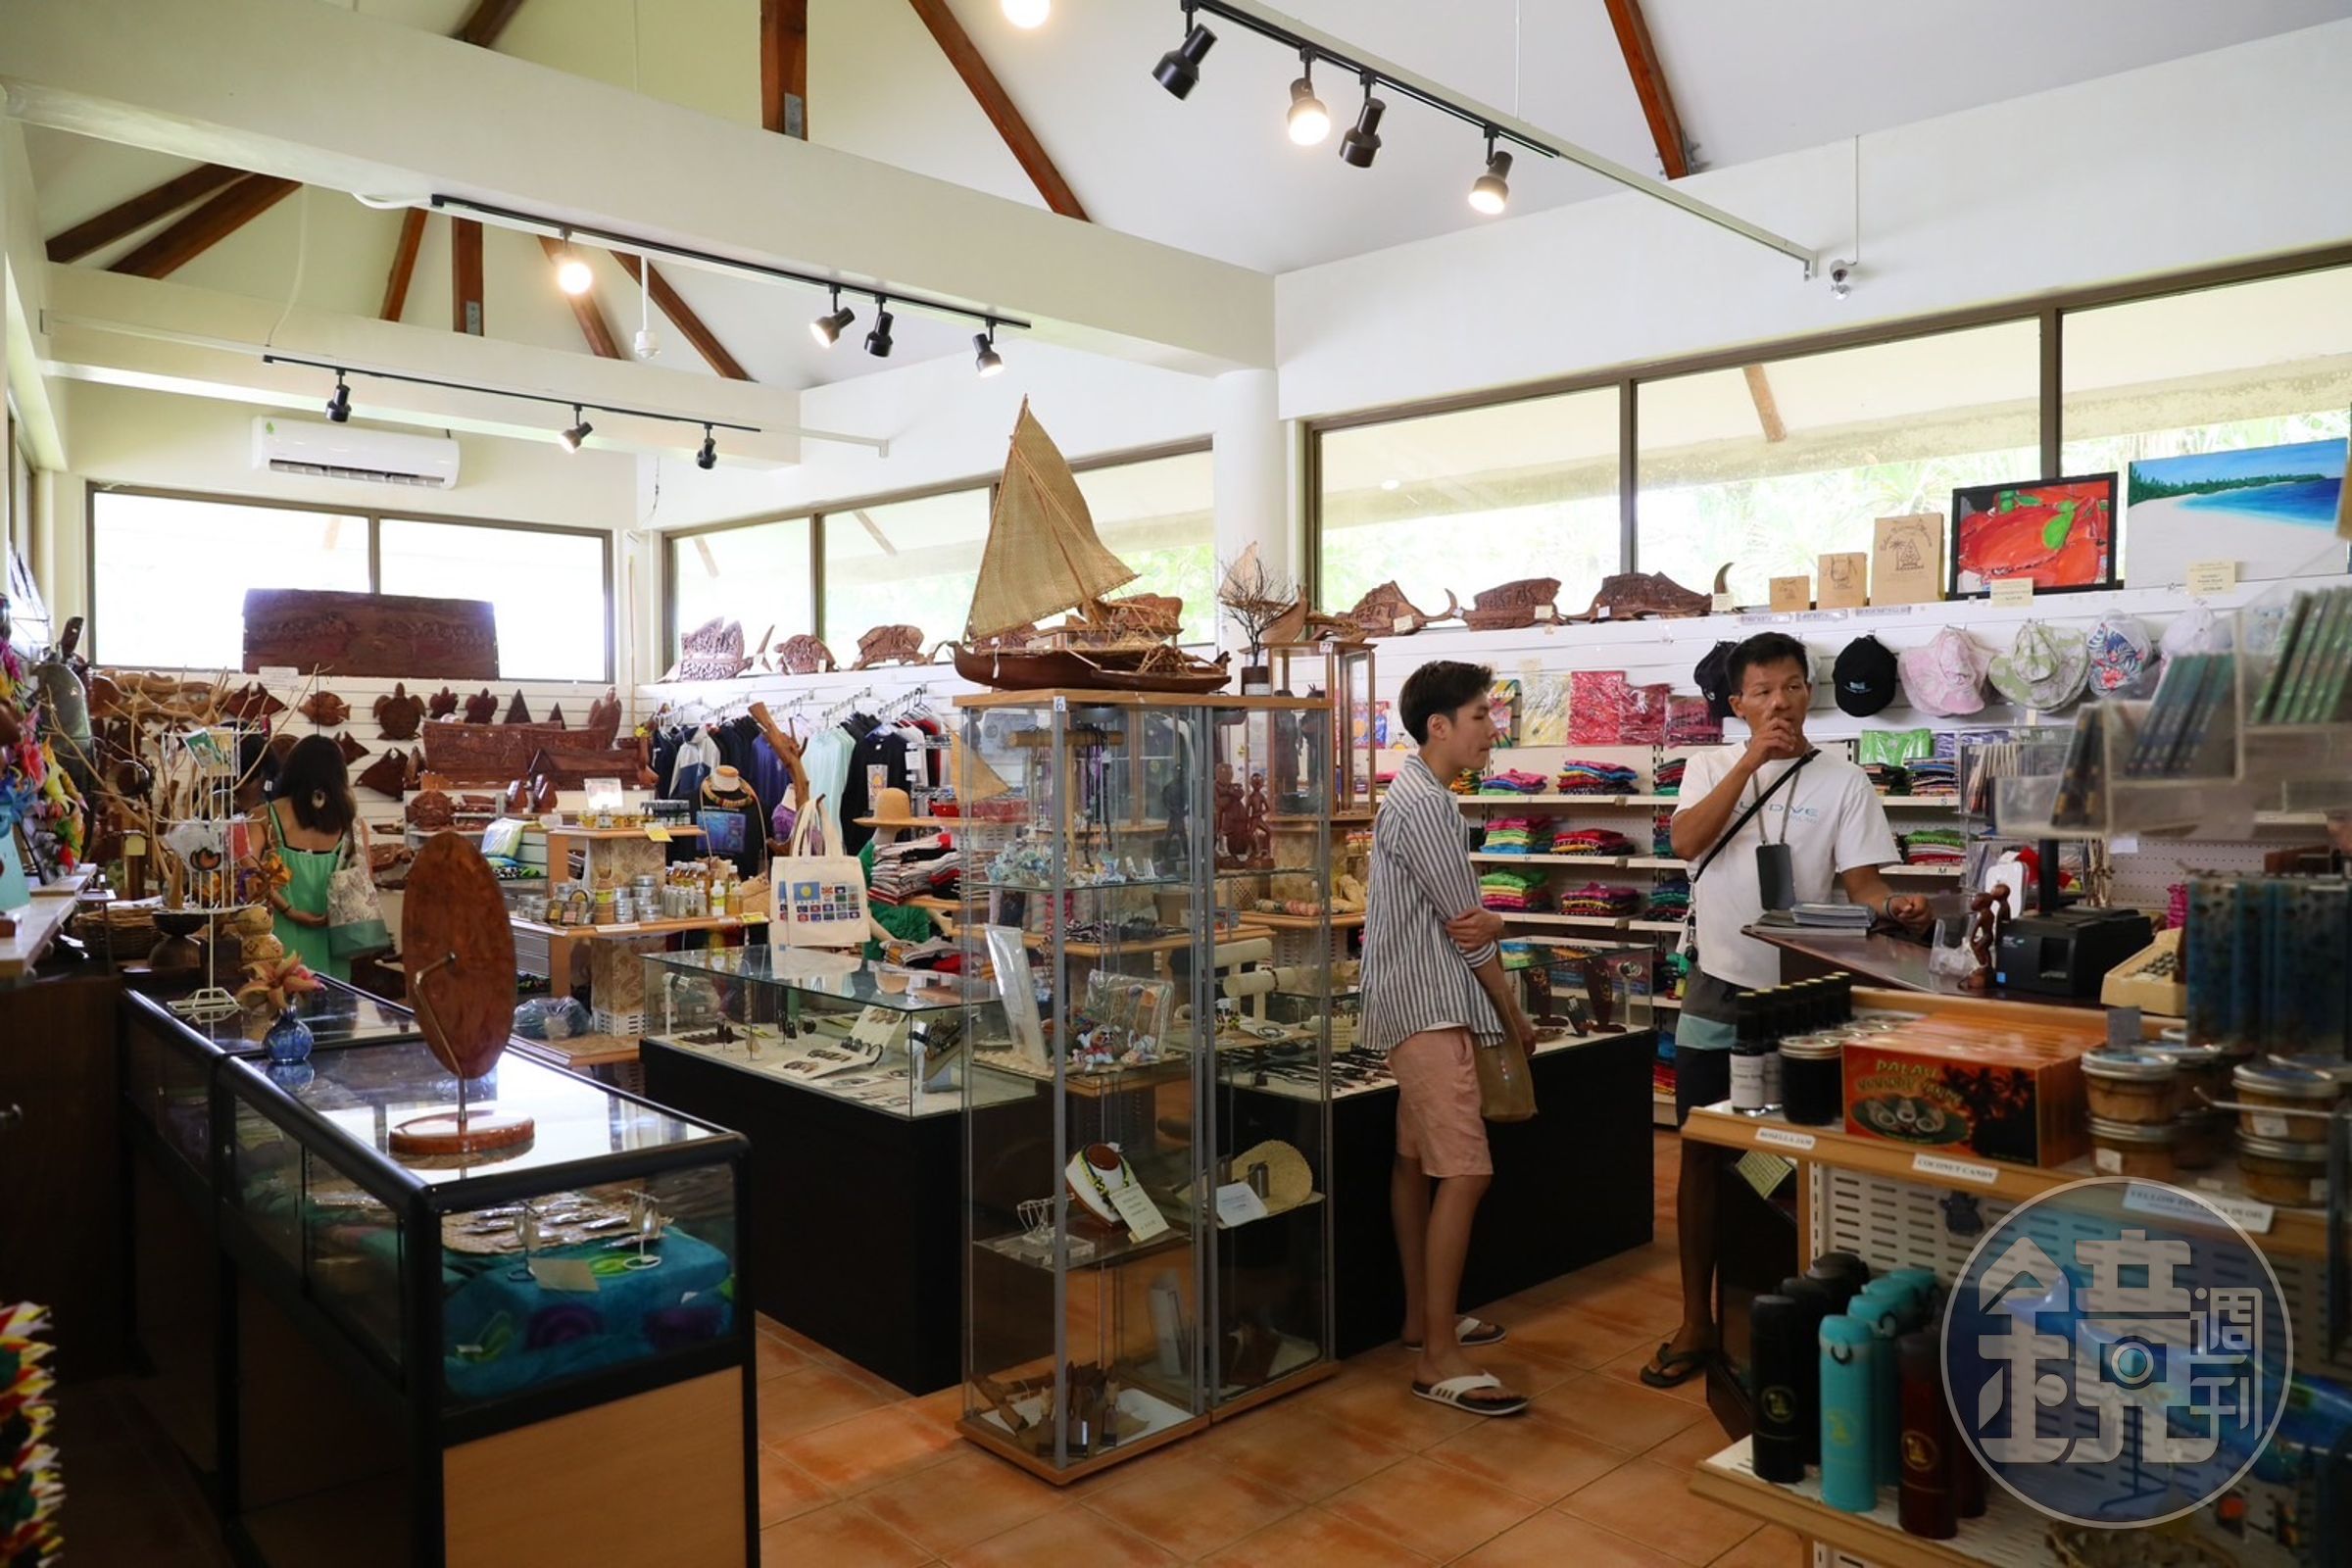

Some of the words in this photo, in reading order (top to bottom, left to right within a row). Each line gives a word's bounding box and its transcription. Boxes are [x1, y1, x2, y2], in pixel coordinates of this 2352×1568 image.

[1055, 697, 1063, 710] 6
[1769, 804, 1820, 817] DVE
[1876, 1058, 1937, 1078] PALAU
[1917, 1157, 1961, 1173] COCONUT
[1962, 1165, 1994, 1179] CANDY
